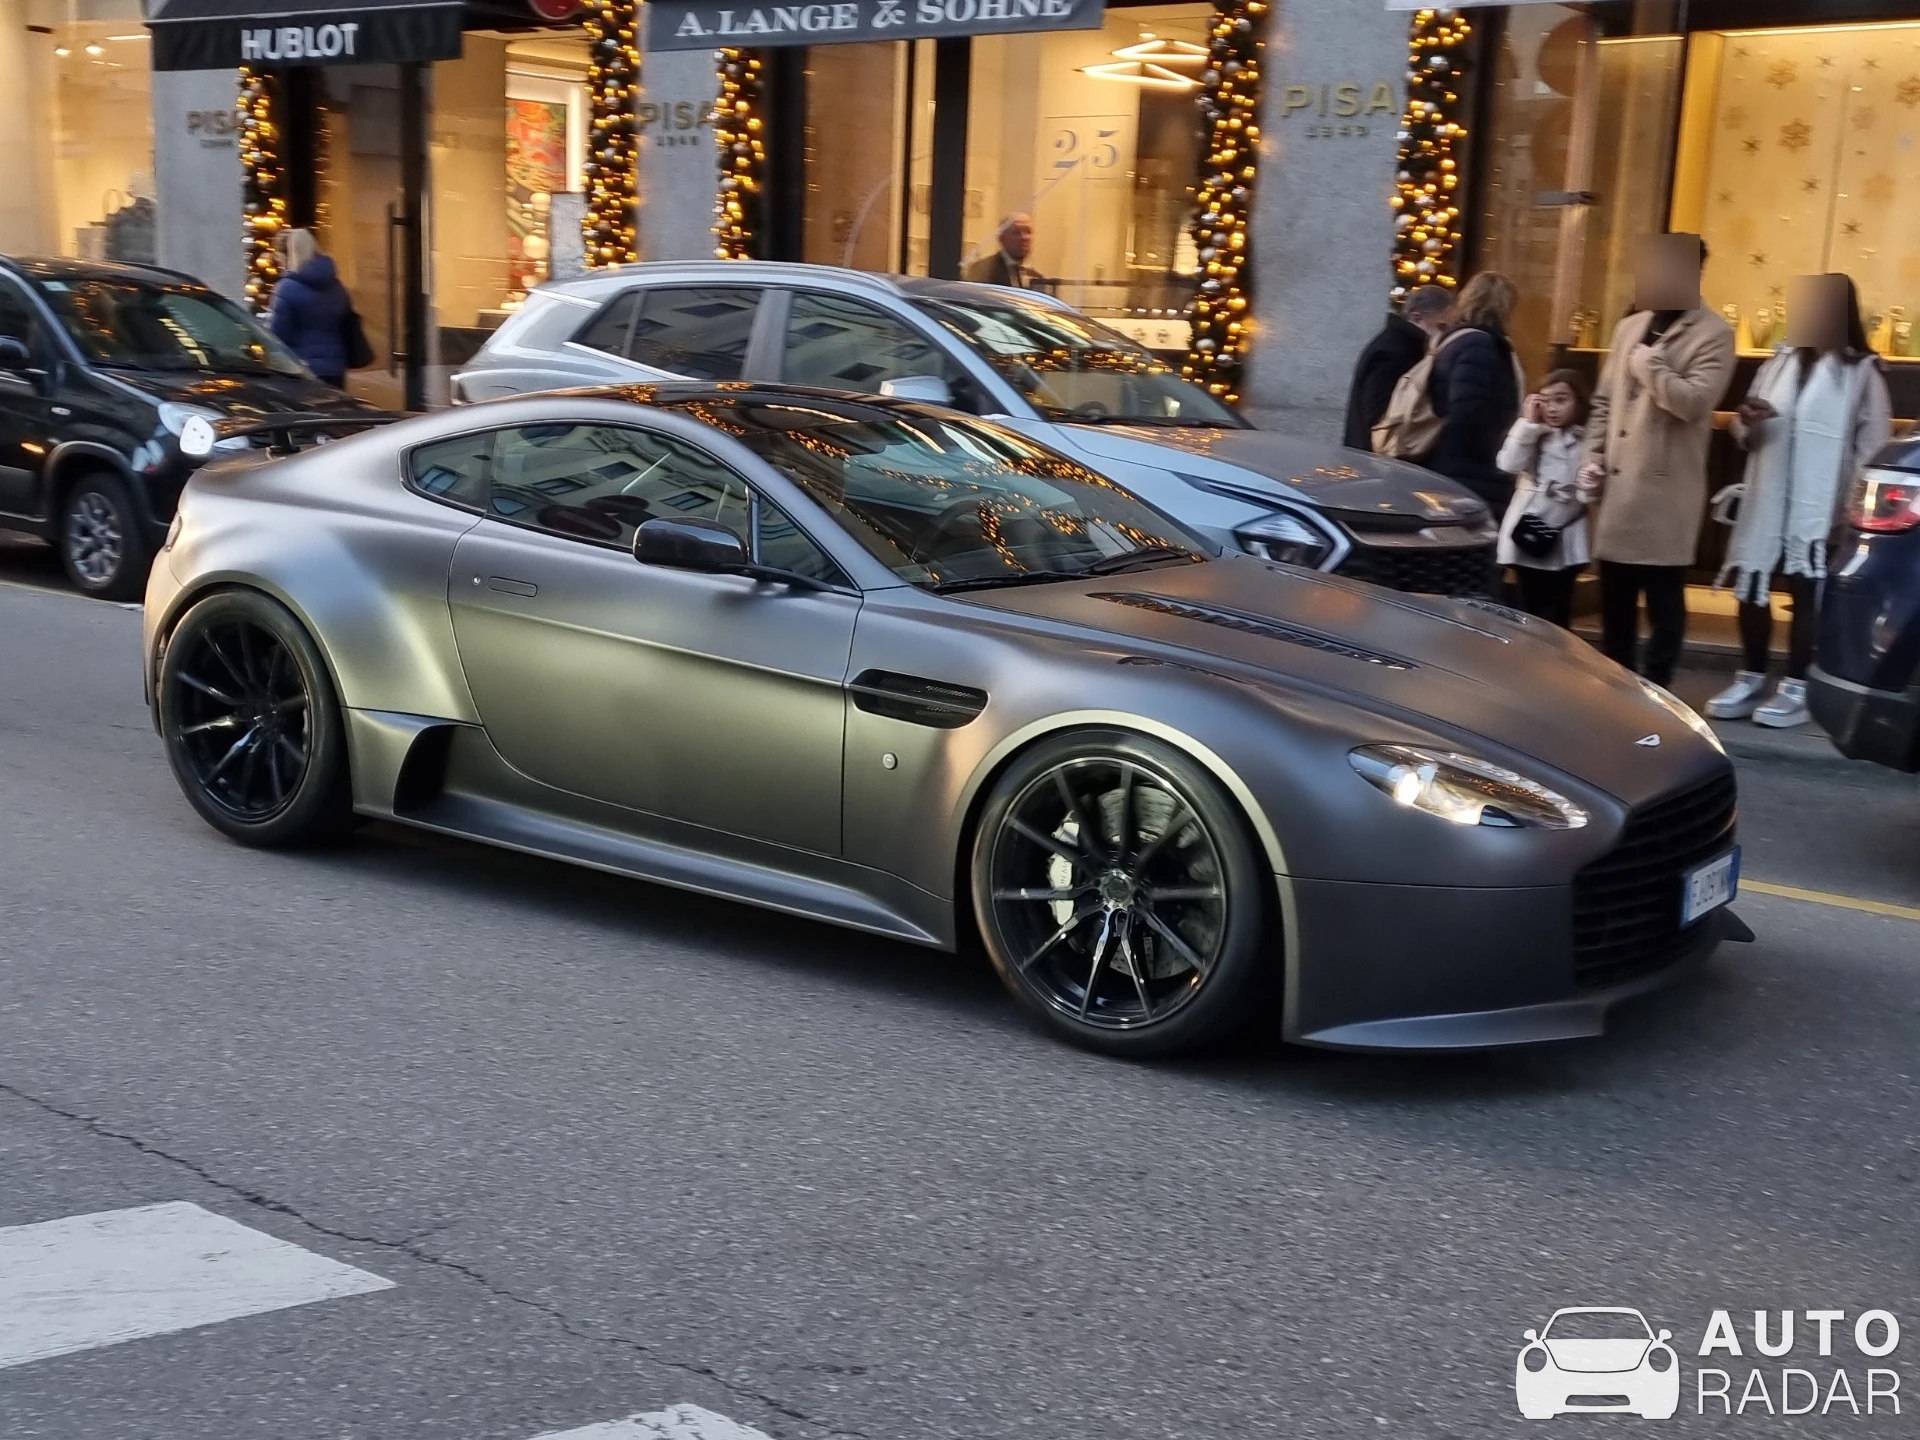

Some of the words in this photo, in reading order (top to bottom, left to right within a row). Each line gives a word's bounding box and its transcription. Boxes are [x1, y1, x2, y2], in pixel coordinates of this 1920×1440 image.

[871, 0, 906, 28] &
[241, 23, 359, 60] HUBLOT
[1280, 81, 1397, 118] PISA
[1053, 129, 1120, 168] 25
